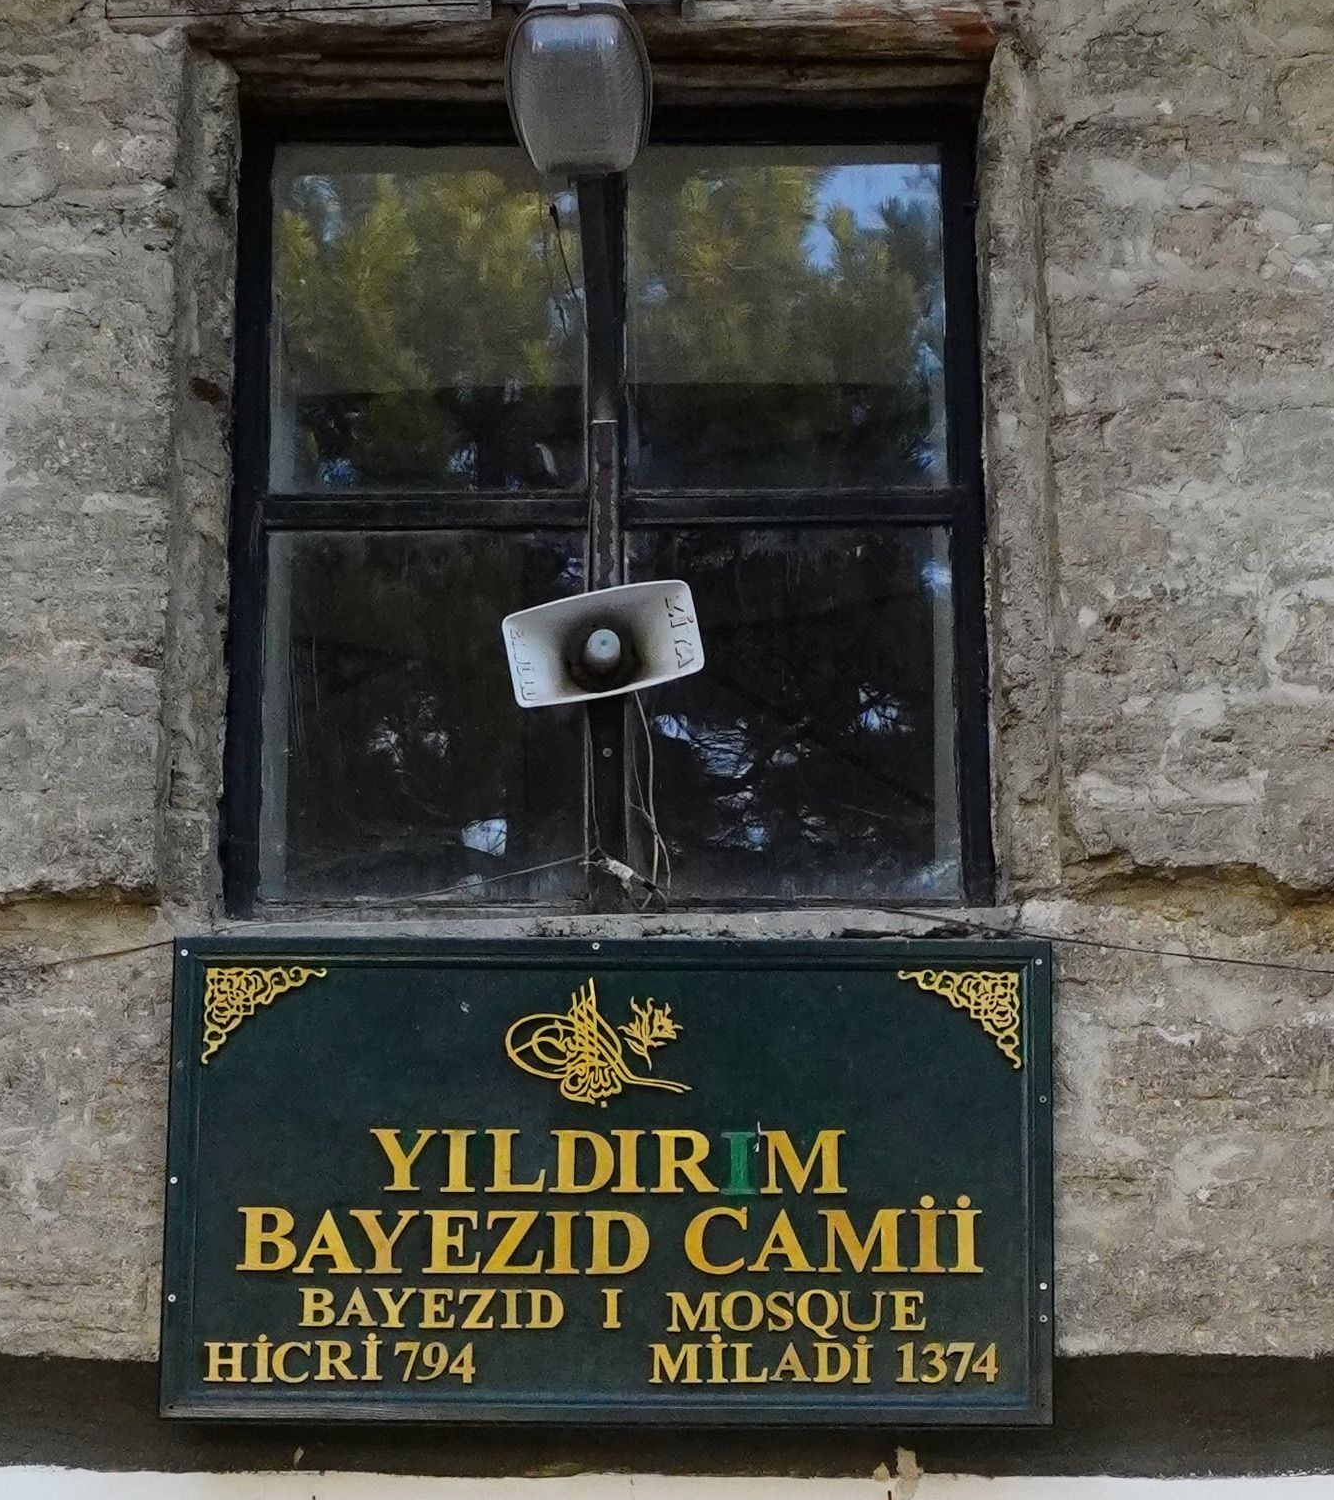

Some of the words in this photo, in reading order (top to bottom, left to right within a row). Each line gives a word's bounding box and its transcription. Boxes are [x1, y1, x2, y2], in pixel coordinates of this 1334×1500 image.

[369, 1127, 848, 1195] YILDIRIM
[236, 1205, 651, 1276] BAYEZID
[684, 1194, 985, 1275] CAMİİ
[298, 1286, 565, 1331] BAYEZID
[602, 1286, 623, 1331] I
[666, 1288, 926, 1334] MOSQUE
[204, 1333, 379, 1384] HİCRİ
[394, 1338, 476, 1384] 794
[648, 1333, 874, 1385] MİLADİ
[898, 1340, 999, 1384] 1374
